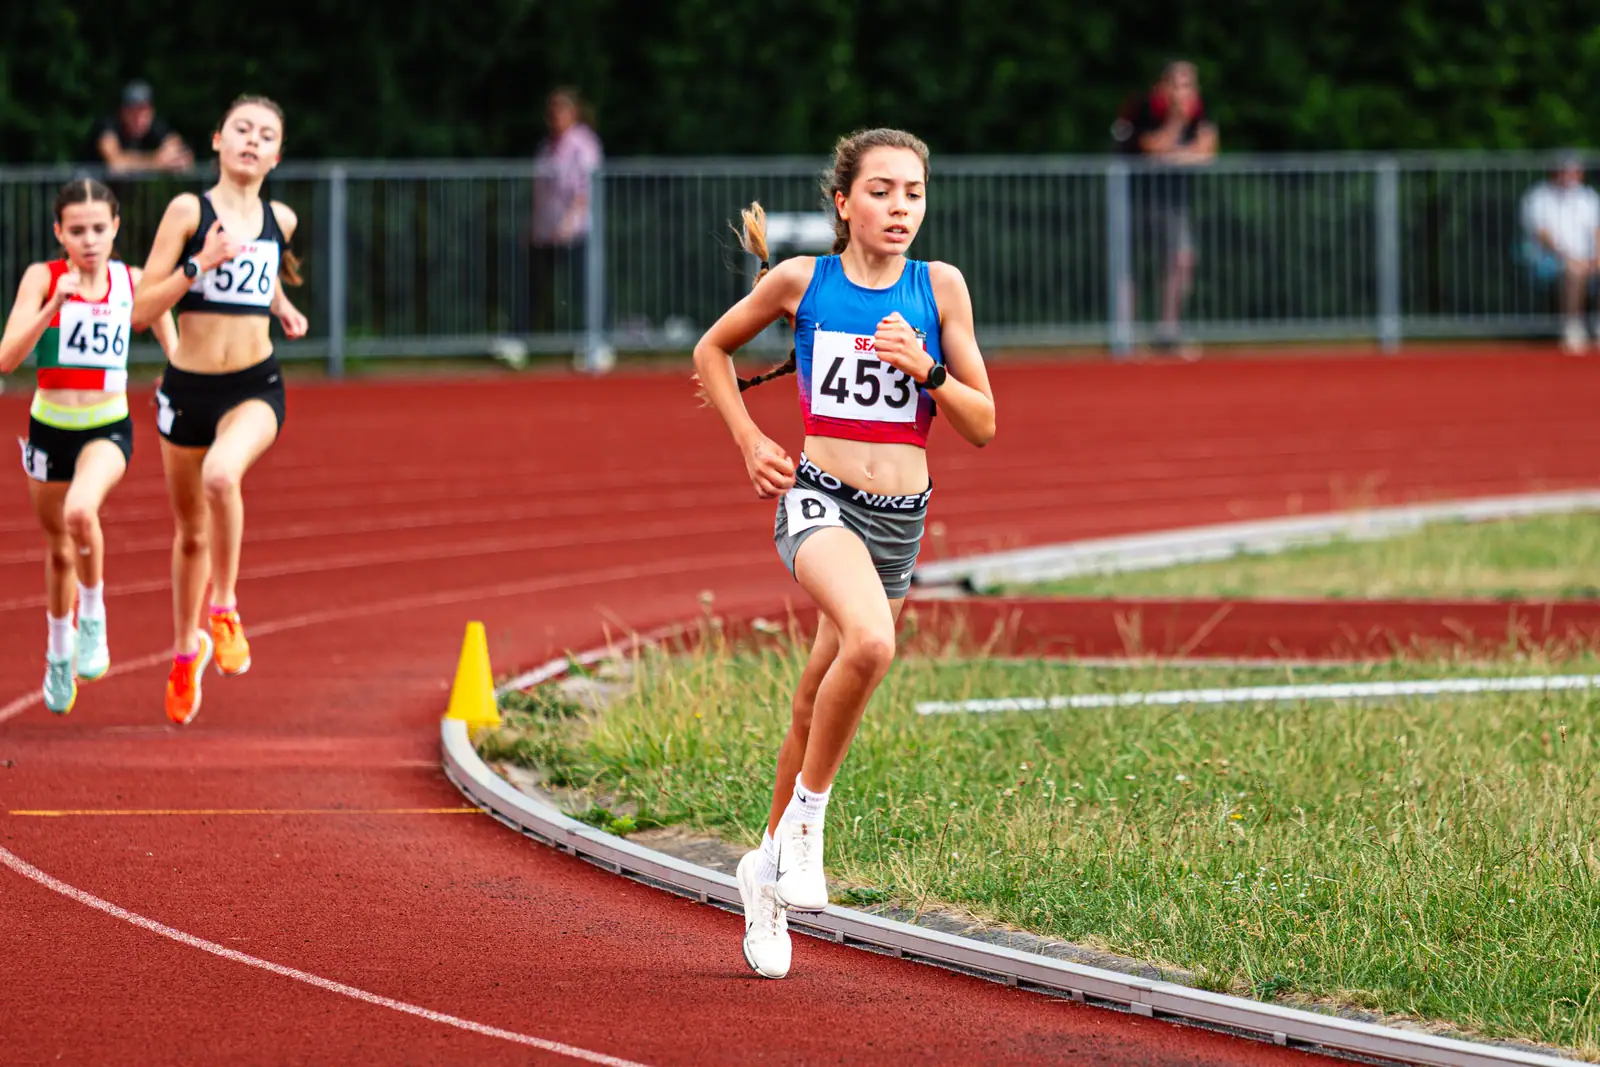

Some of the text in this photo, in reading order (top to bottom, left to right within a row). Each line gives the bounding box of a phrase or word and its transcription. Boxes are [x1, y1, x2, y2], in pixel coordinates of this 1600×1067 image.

[214, 260, 270, 295] 526
[67, 320, 124, 356] 456
[820, 356, 911, 409] 453
[852, 490, 920, 509] NIKE
